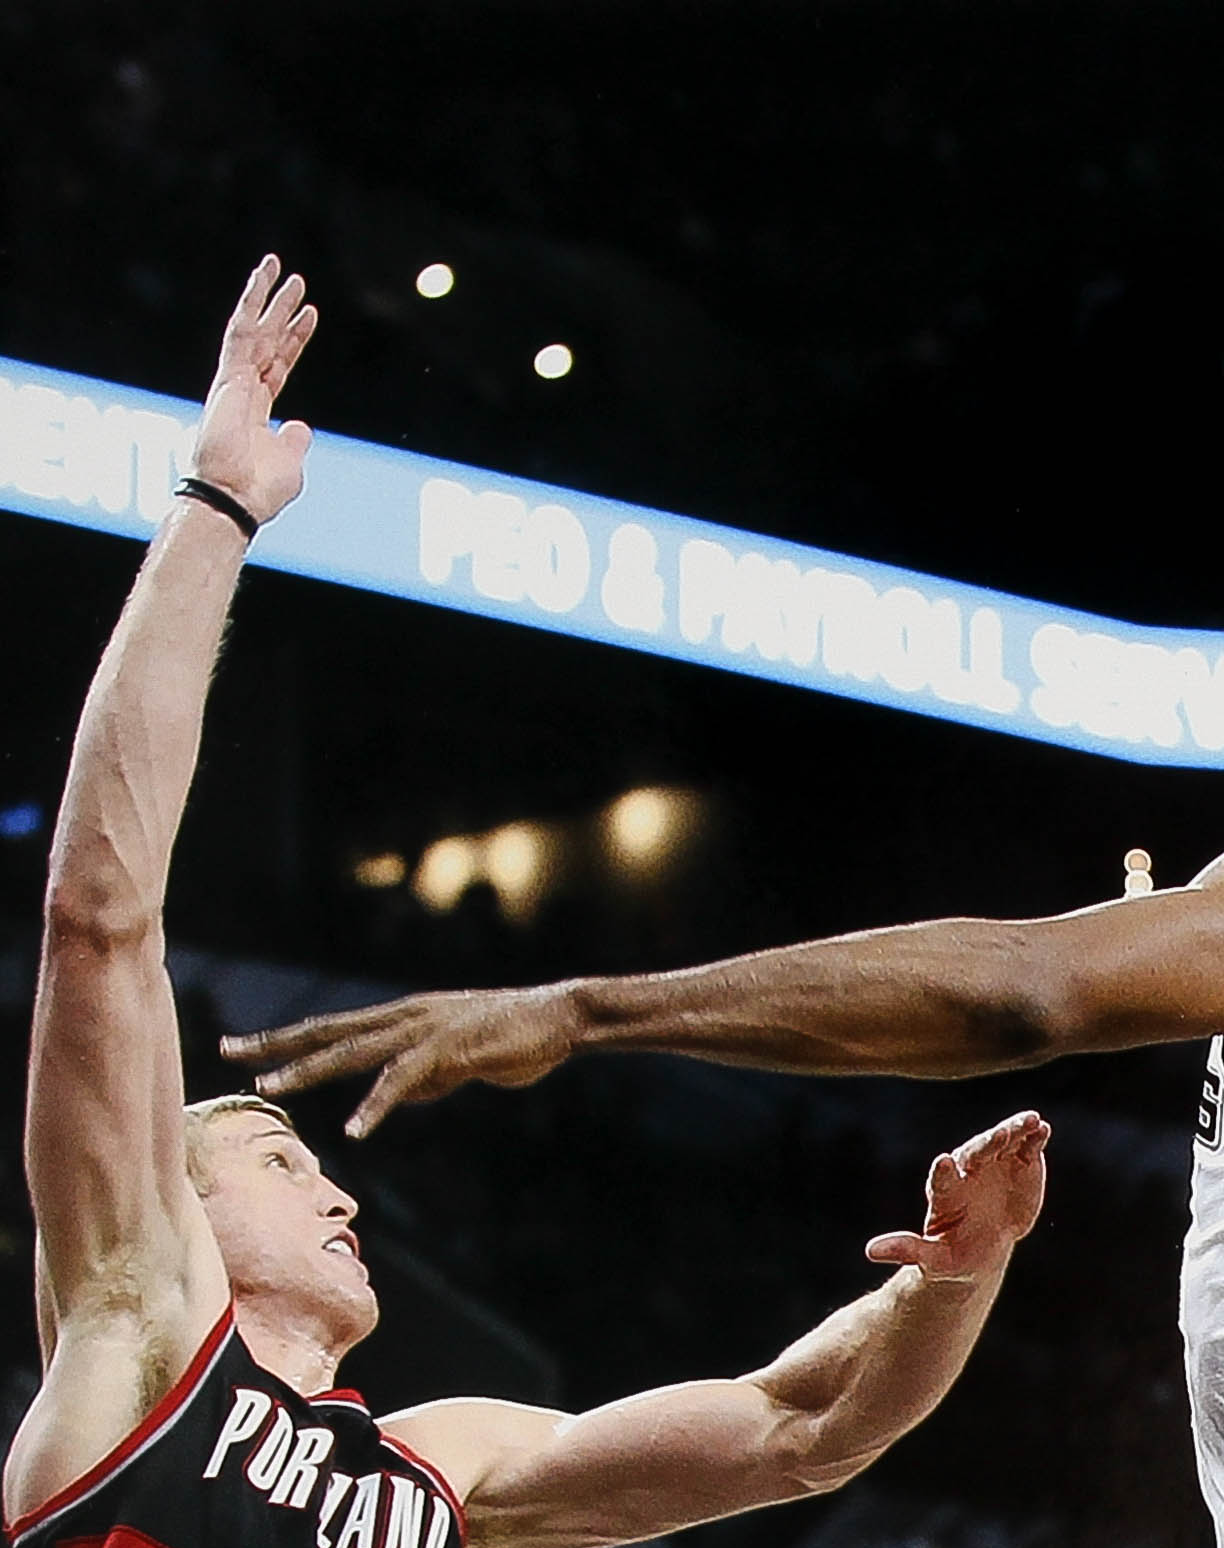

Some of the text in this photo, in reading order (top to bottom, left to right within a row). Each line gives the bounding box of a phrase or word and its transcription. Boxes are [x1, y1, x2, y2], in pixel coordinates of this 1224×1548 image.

[418, 478, 590, 613] PEO
[602, 523, 665, 633] &
[679, 538, 1020, 714] PAYROLL
